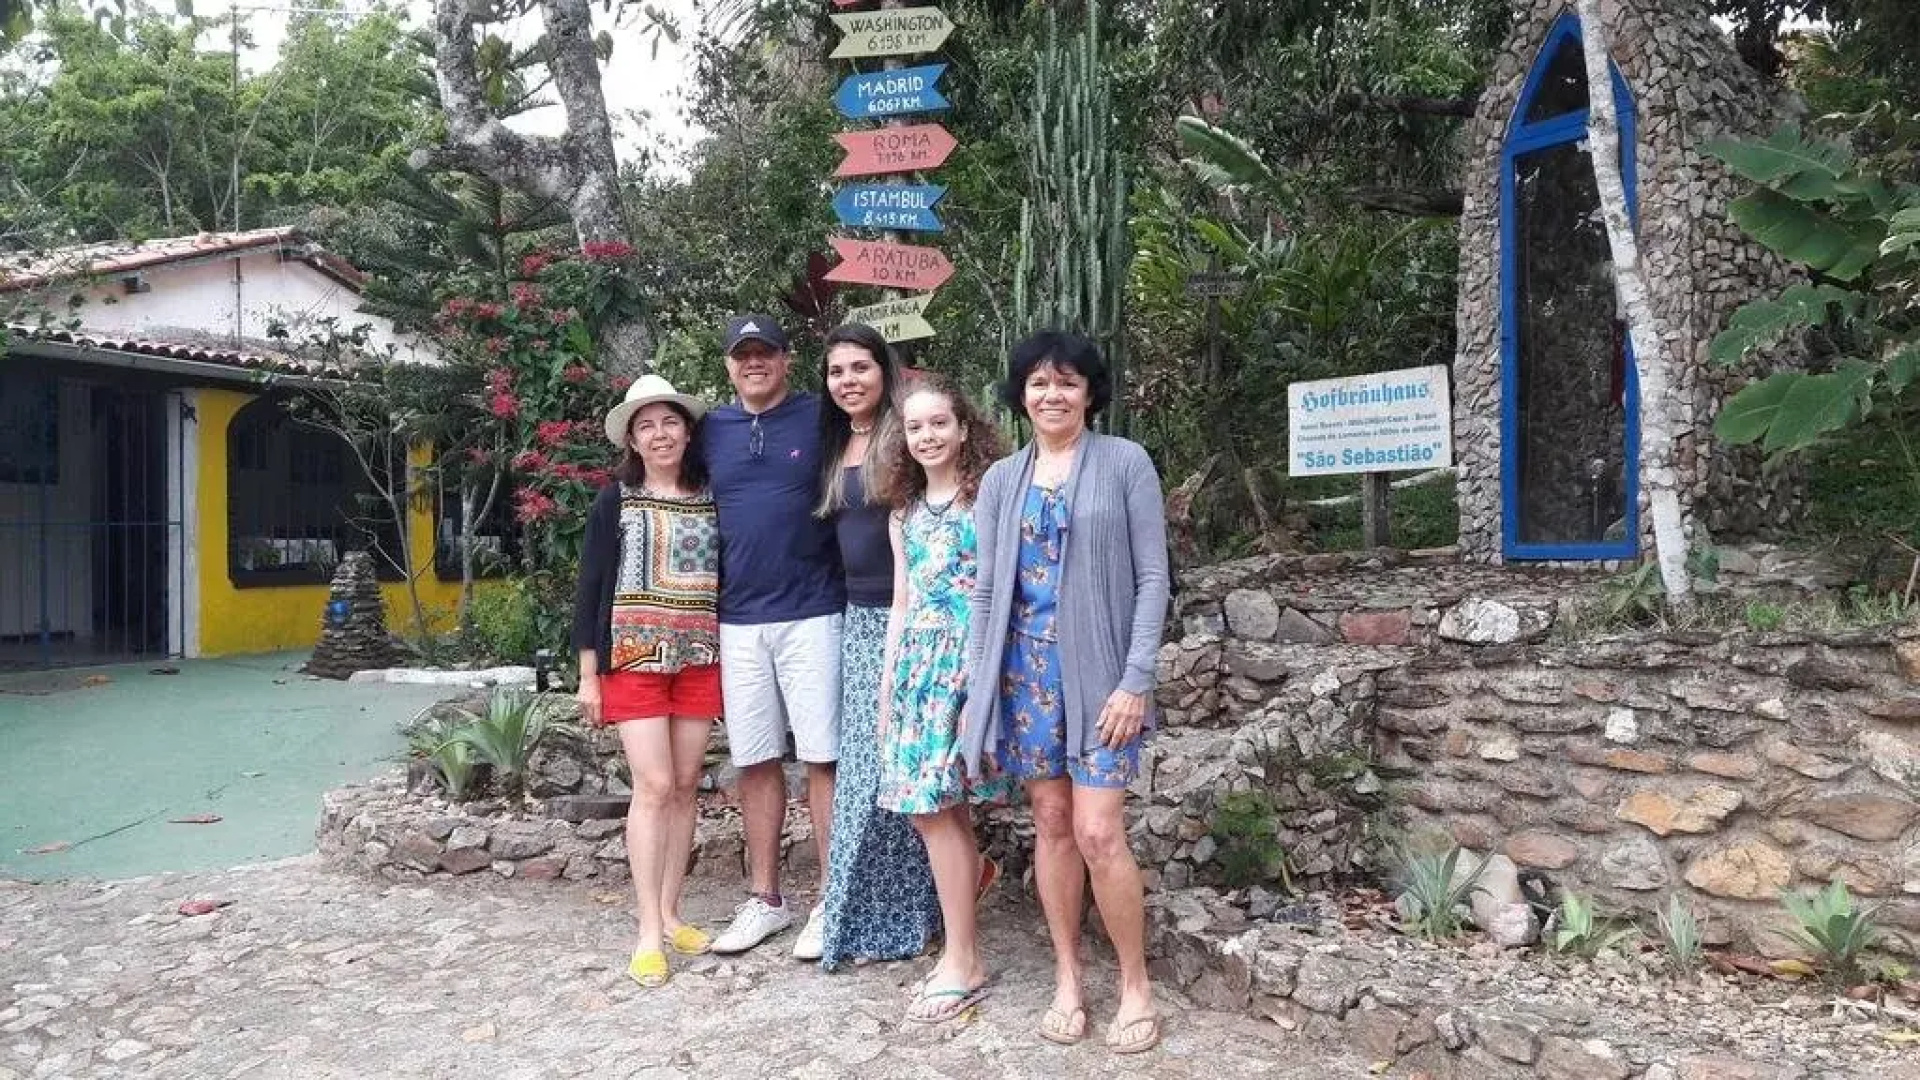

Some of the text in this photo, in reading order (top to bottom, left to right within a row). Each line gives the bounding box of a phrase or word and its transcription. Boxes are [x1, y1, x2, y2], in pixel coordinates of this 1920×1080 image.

[850, 13, 943, 34] WASHINGTON
[858, 75, 923, 98] MADRID
[873, 132, 931, 151] ROMA
[854, 190, 929, 210] ISTAMBUL
[856, 246, 940, 271] ARATUBA
[873, 267, 889, 280] 10
[1301, 381, 1430, 412] Hofbräuhaus
